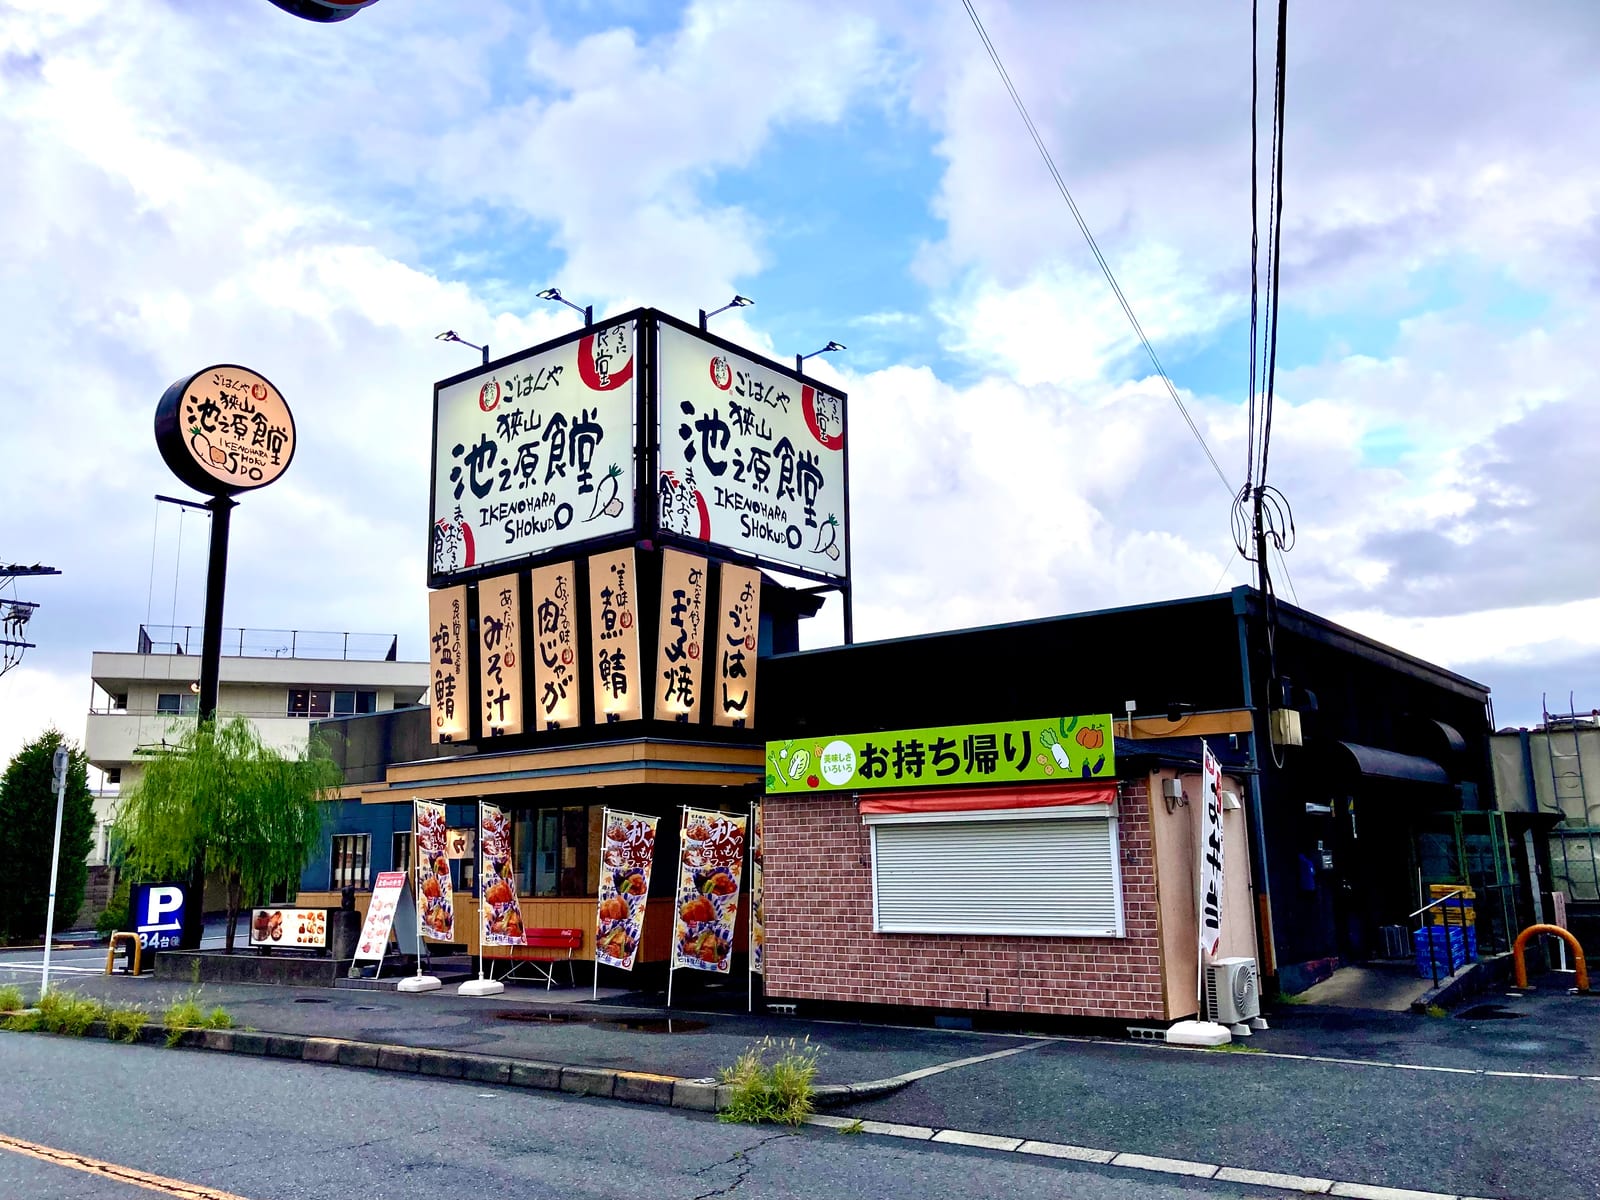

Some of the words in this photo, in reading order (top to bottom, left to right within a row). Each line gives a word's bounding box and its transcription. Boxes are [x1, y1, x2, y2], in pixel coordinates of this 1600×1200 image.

[213, 374, 250, 393] ごはんや
[220, 390, 256, 414] 狭山
[503, 365, 564, 403] ごはんや
[735, 371, 790, 413] ごはんや
[496, 408, 541, 443] 狭山
[729, 401, 772, 440] 狭山
[220, 437, 269, 459] IKENOHARA
[479, 491, 556, 527] IKENOHARA
[504, 502, 574, 544] SHOKUDO
[714, 486, 787, 523] IKENOHARA
[740, 513, 802, 549] SHOKUDO
[740, 580, 756, 633] おいしい
[537, 597, 573, 714] 肉じゃが
[599, 586, 628, 699] 煮鯖
[664, 589, 695, 708] 玉子焼
[723, 604, 749, 713] ごはん
[483, 615, 510, 721] みそ汁
[823, 764, 853, 774] いろいろ
[858, 730, 1032, 779] お持ち帰り
[702, 839, 743, 859] 旨いもん
[708, 817, 744, 847] 秋の
[147, 886, 183, 925] P
